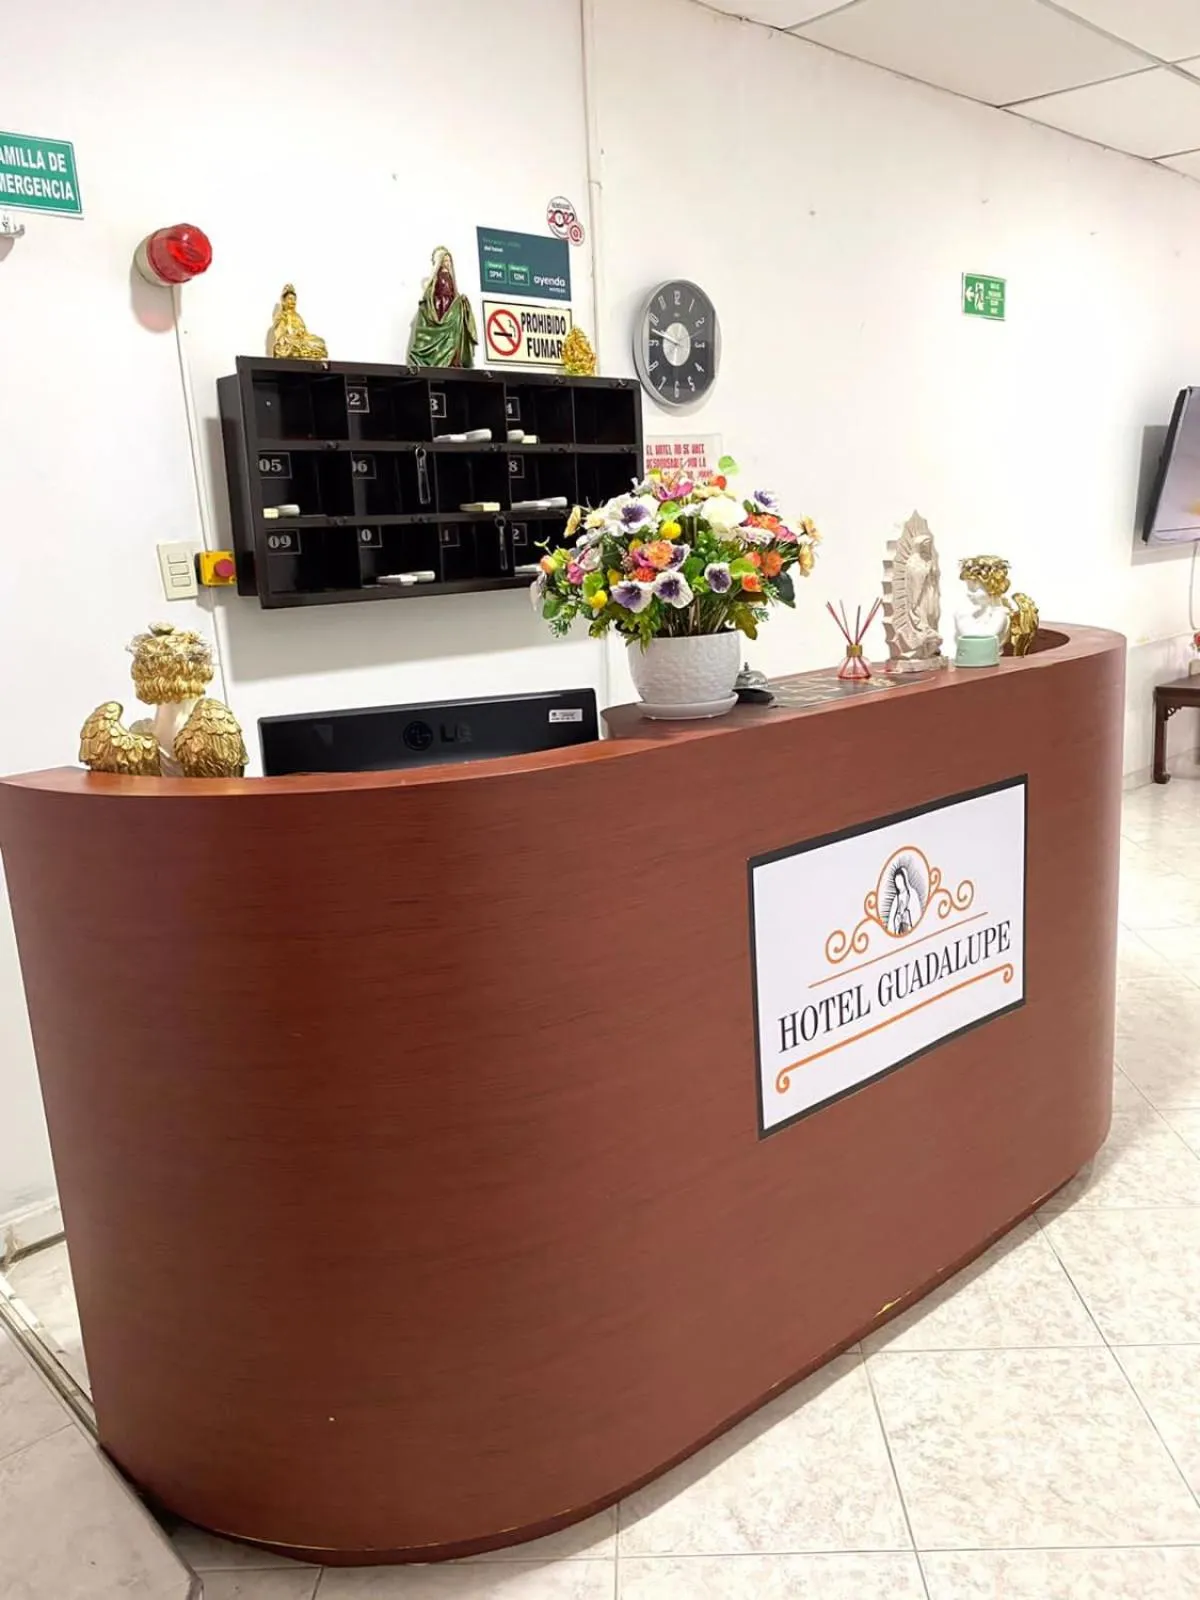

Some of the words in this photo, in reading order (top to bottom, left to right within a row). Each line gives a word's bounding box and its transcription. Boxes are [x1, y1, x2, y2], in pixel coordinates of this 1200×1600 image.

[48, 151, 67, 173] DE
[521, 312, 566, 336] PROHIBIDO
[527, 337, 564, 359] FUMAR
[258, 458, 283, 472] 05
[268, 534, 292, 549] 09
[777, 984, 872, 1054] HOTEL
[877, 920, 1012, 1008] GUADALUPE
